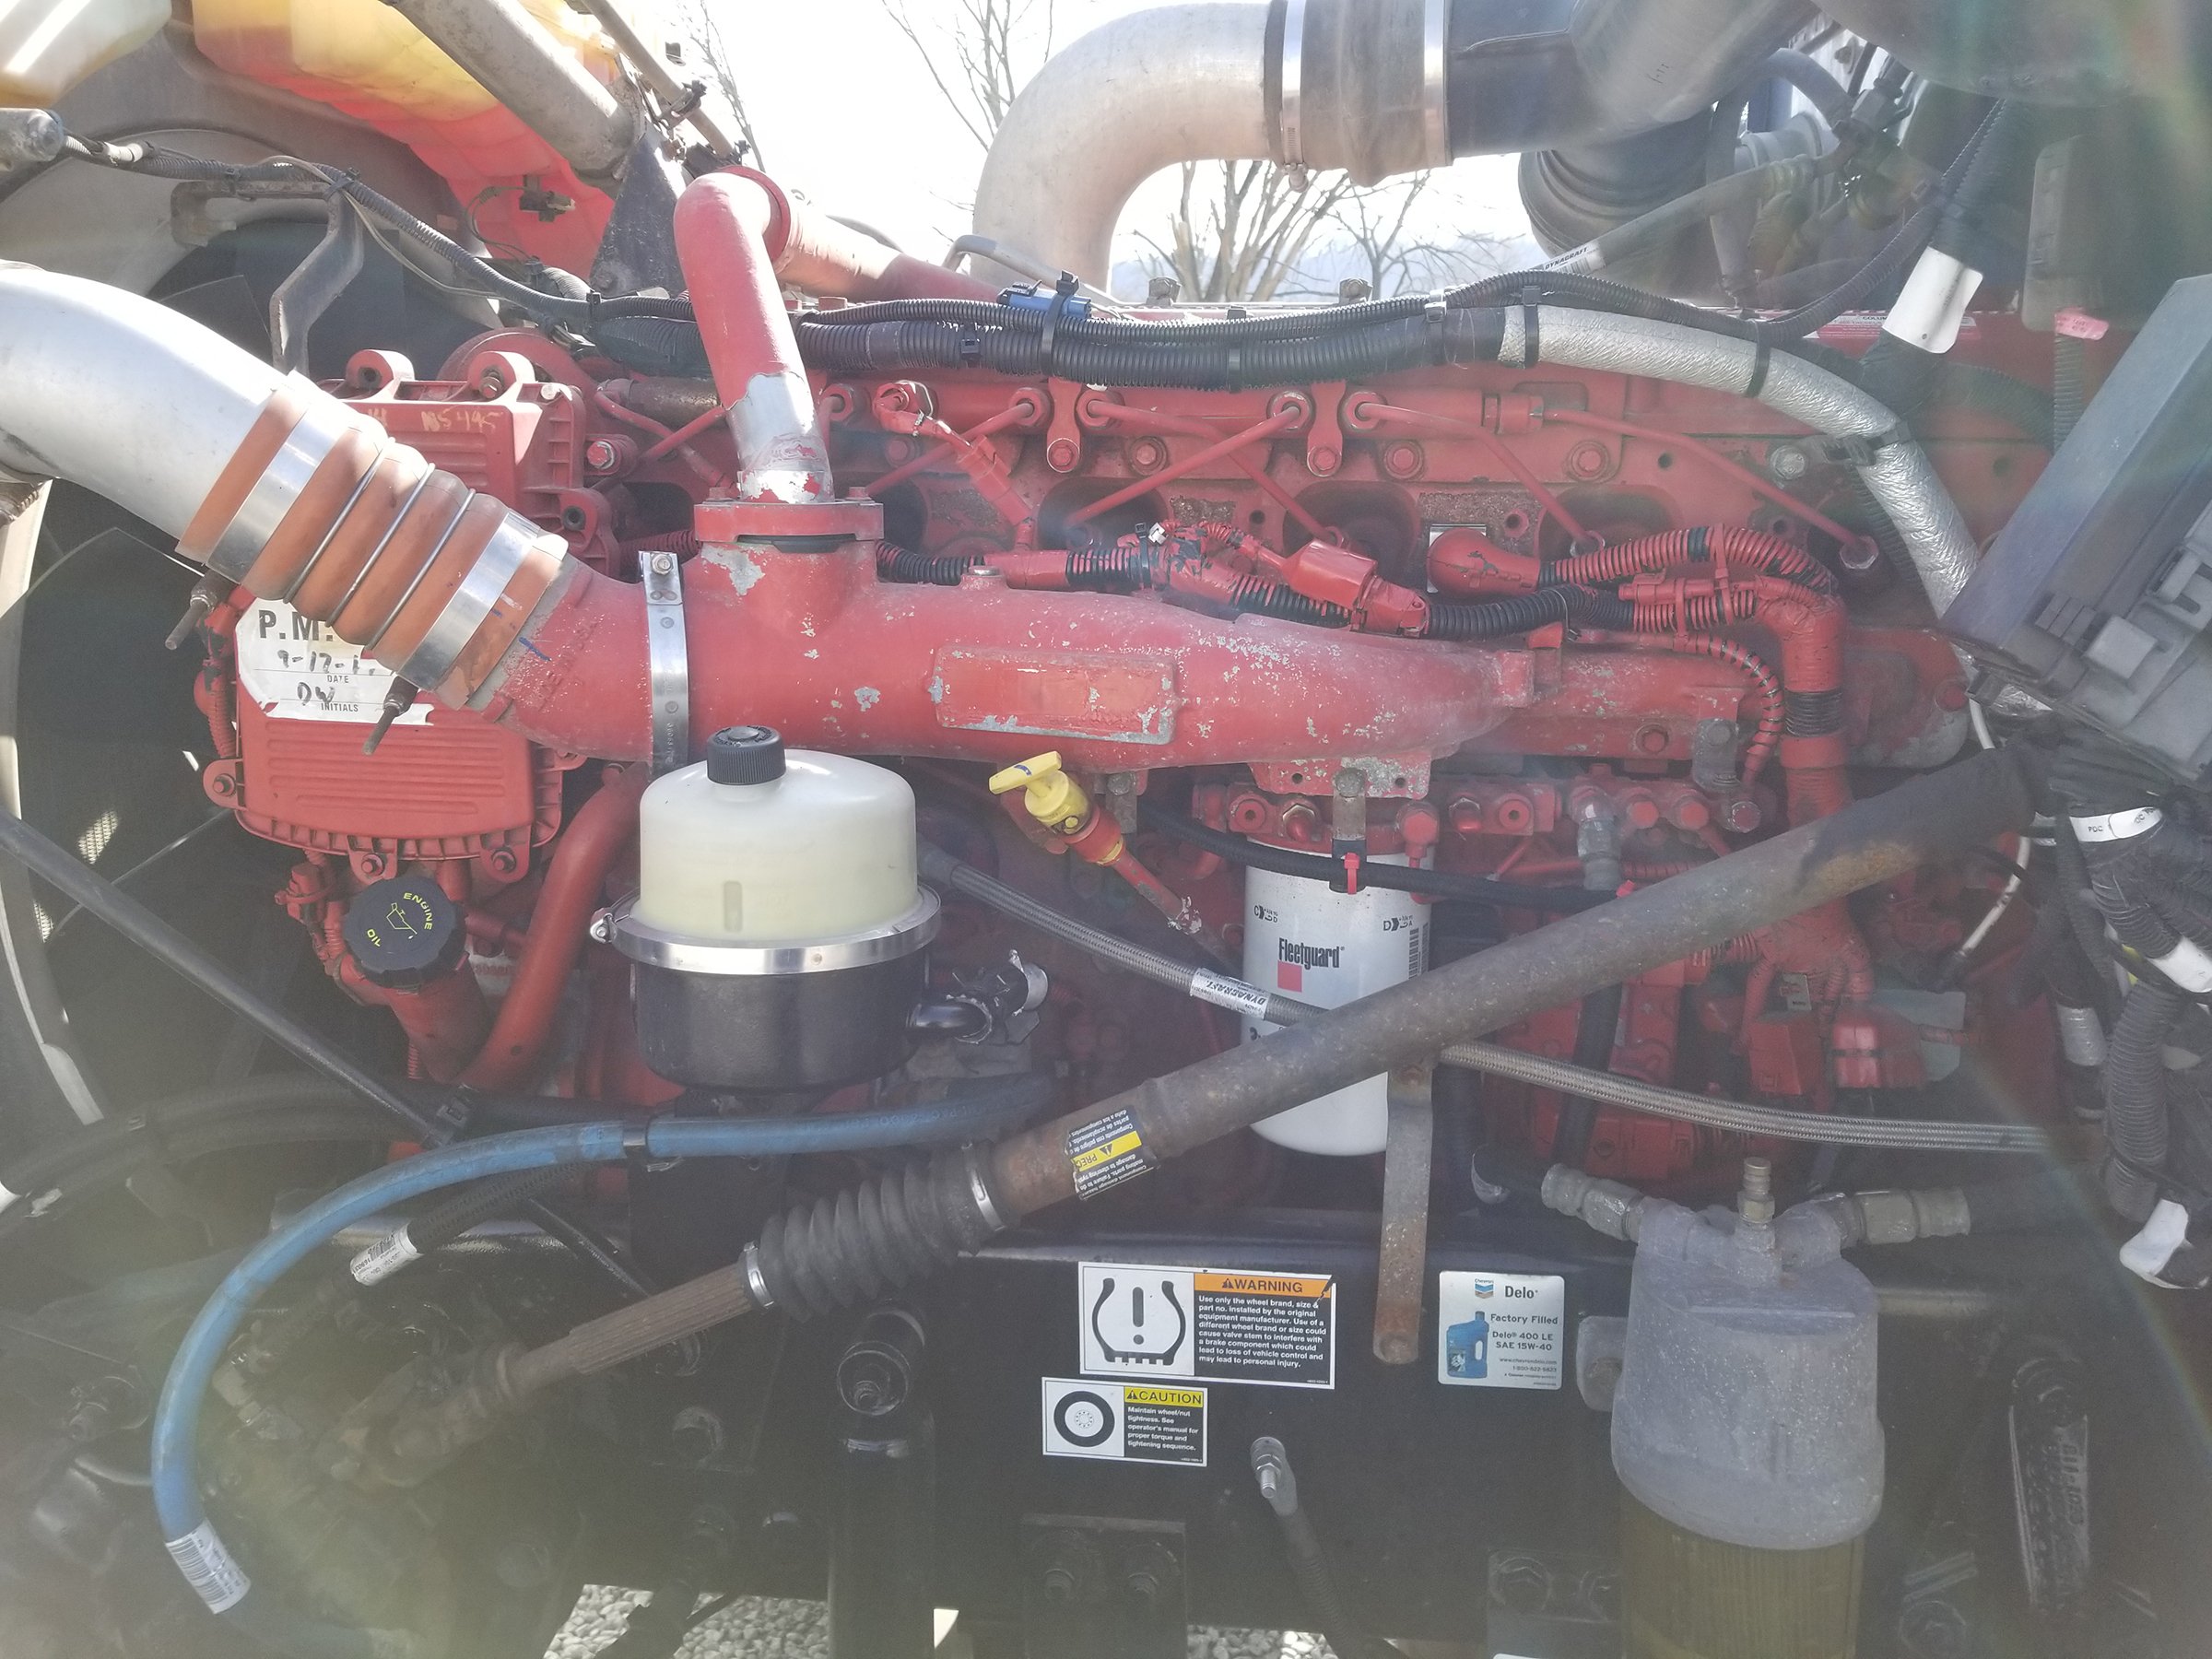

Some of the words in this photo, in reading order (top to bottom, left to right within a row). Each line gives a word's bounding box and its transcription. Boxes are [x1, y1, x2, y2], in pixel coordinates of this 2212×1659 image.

[1545, 247, 1587, 269] DYNACRAFT
[327, 675, 349, 683] DATE
[321, 702, 359, 712] INITIALS
[403, 892, 433, 930] ENGINE
[1253, 905, 1259, 916] C
[1383, 920, 1392, 931] D
[367, 928, 381, 947] OIL
[1080, 1139, 1096, 1150] peligro
[1115, 1154, 1135, 1165] damage
[1088, 1166, 1110, 1178] steering
[1093, 1174, 1111, 1184] Failure
[1234, 1279, 1303, 1293] WARNING
[1215, 1297, 1231, 1306] only
[1246, 1298, 1269, 1306] wheel
[1230, 1306, 1260, 1314] installed
[1262, 1308, 1272, 1316] by
[1288, 1310, 1315, 1318] original
[1198, 1313, 1239, 1323] equipment
[1240, 1315, 1291, 1324] manufacturer.
[1490, 1313, 1528, 1324] Factory
[1531, 1315, 1559, 1324] Filled
[1274, 1334, 1305, 1343] interfere
[1541, 1333, 1554, 1341] LE
[1228, 1340, 1270, 1349] component
[1271, 1342, 1293, 1350] which
[1517, 1342, 1552, 1351] 15W-40
[1253, 1349, 1279, 1358] vehicle
[1280, 1351, 1307, 1359] control
[1242, 1358, 1276, 1366] personal
[1277, 1359, 1301, 1368] injury.
[1139, 1391, 1202, 1404] CAUTION
[1158, 1408, 1191, 1417] wheel/nut
[1128, 1441, 1161, 1449] tightening
